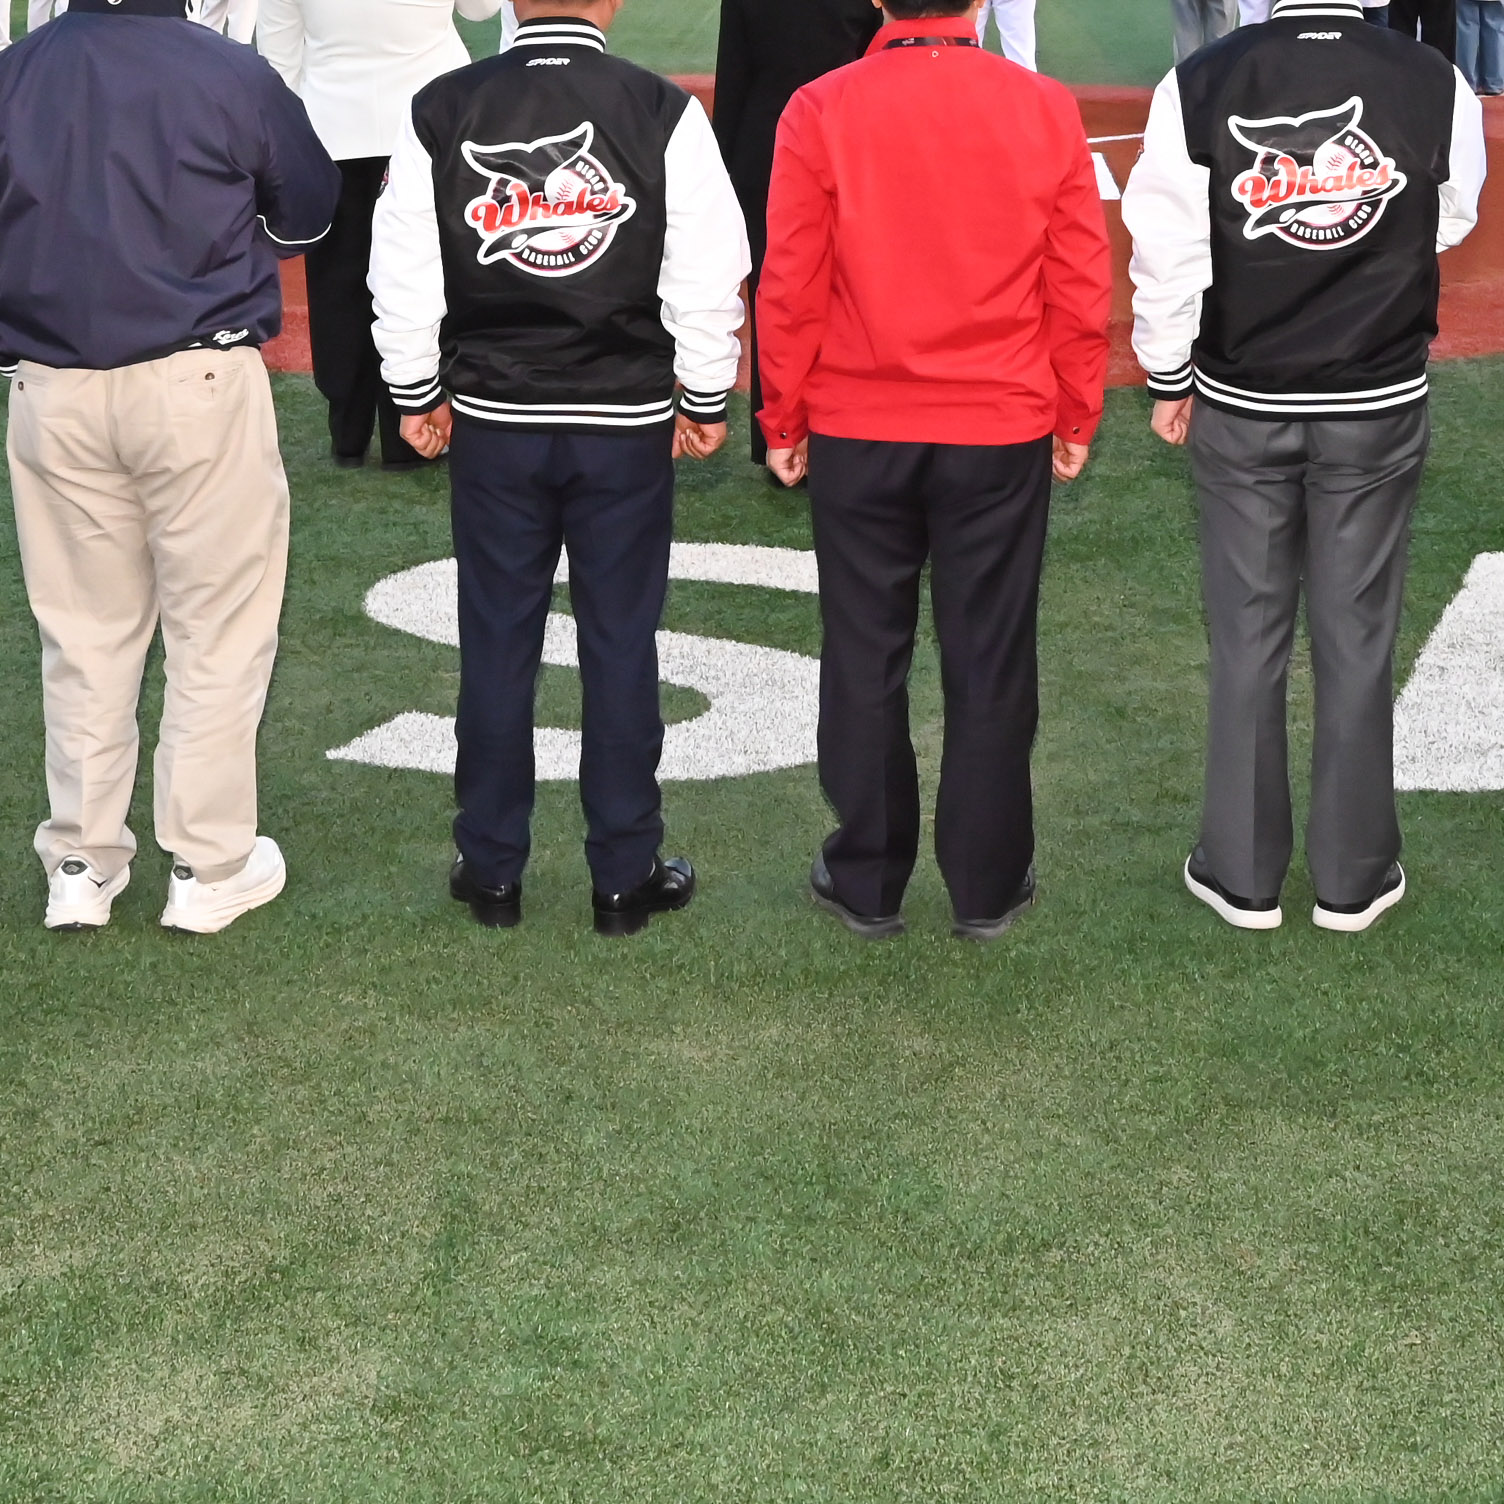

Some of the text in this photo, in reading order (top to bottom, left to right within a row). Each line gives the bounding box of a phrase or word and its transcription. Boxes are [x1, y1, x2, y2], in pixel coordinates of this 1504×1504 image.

[1297, 31, 1342, 40] SPYDER
[526, 57, 570, 67] SPYDER
[1344, 135, 1375, 165] ULSAN
[575, 160, 606, 191] ULSAN
[1237, 156, 1391, 208] Whales
[471, 183, 621, 233] Whales
[1290, 205, 1373, 240] BASEBALL CLUB
[521, 230, 603, 266] BASEBALL CLUB
